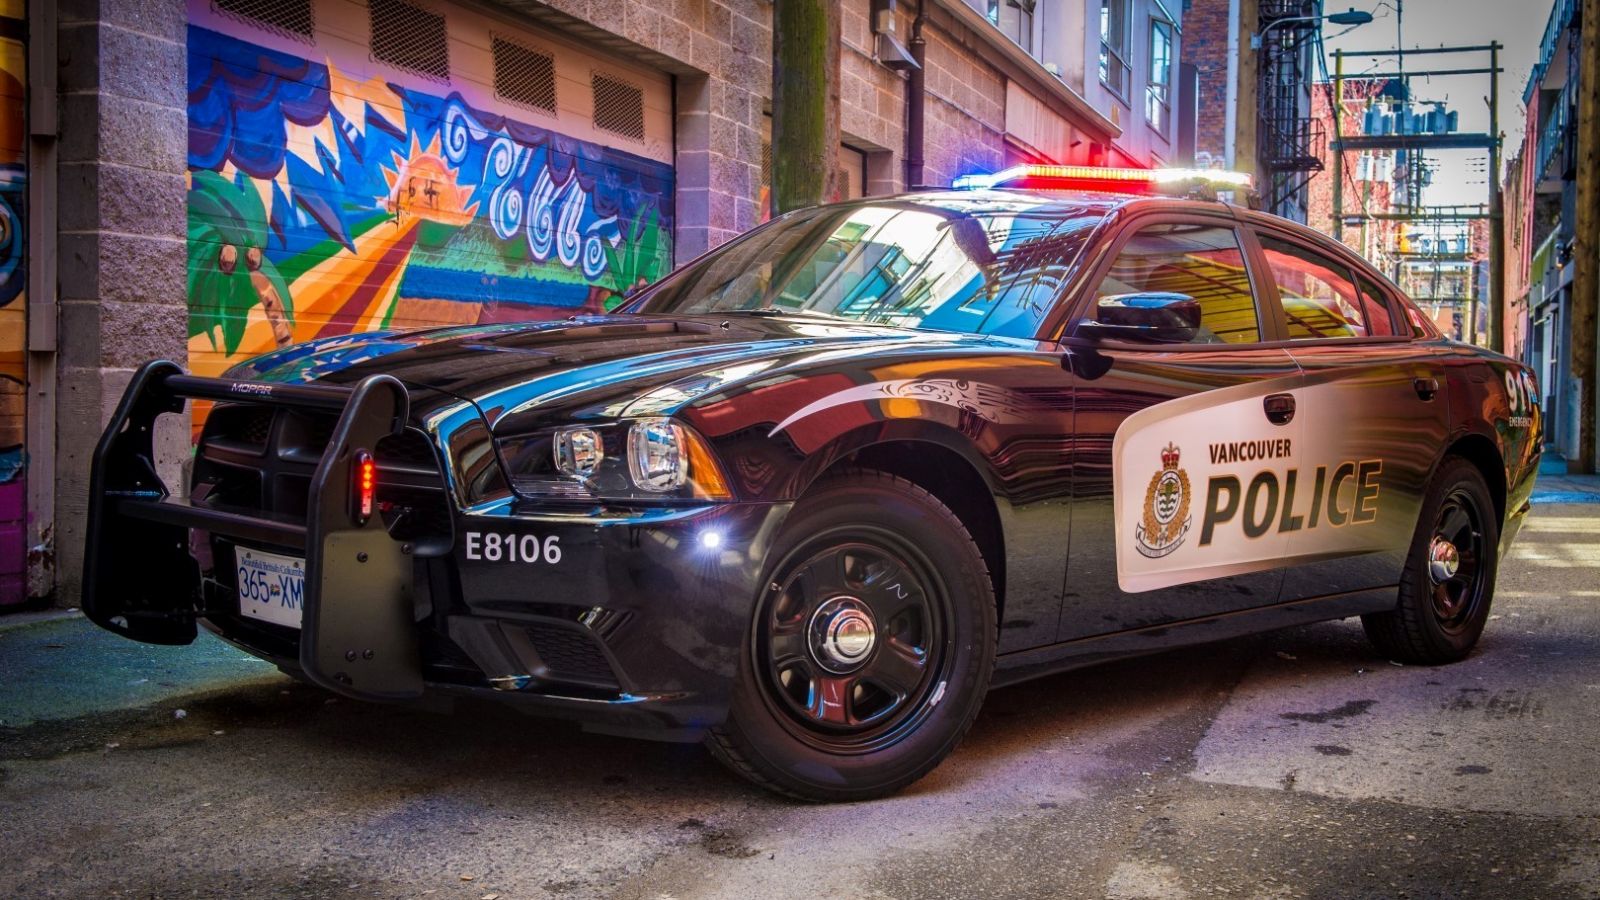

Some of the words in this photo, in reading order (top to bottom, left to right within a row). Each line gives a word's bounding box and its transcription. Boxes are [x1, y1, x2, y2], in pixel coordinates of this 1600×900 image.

[231, 382, 273, 395] MOPAR
[1209, 438, 1292, 464] VANCOUVER
[1198, 459, 1383, 547] POLICE
[466, 532, 562, 564] E8106
[239, 566, 270, 603] 365
